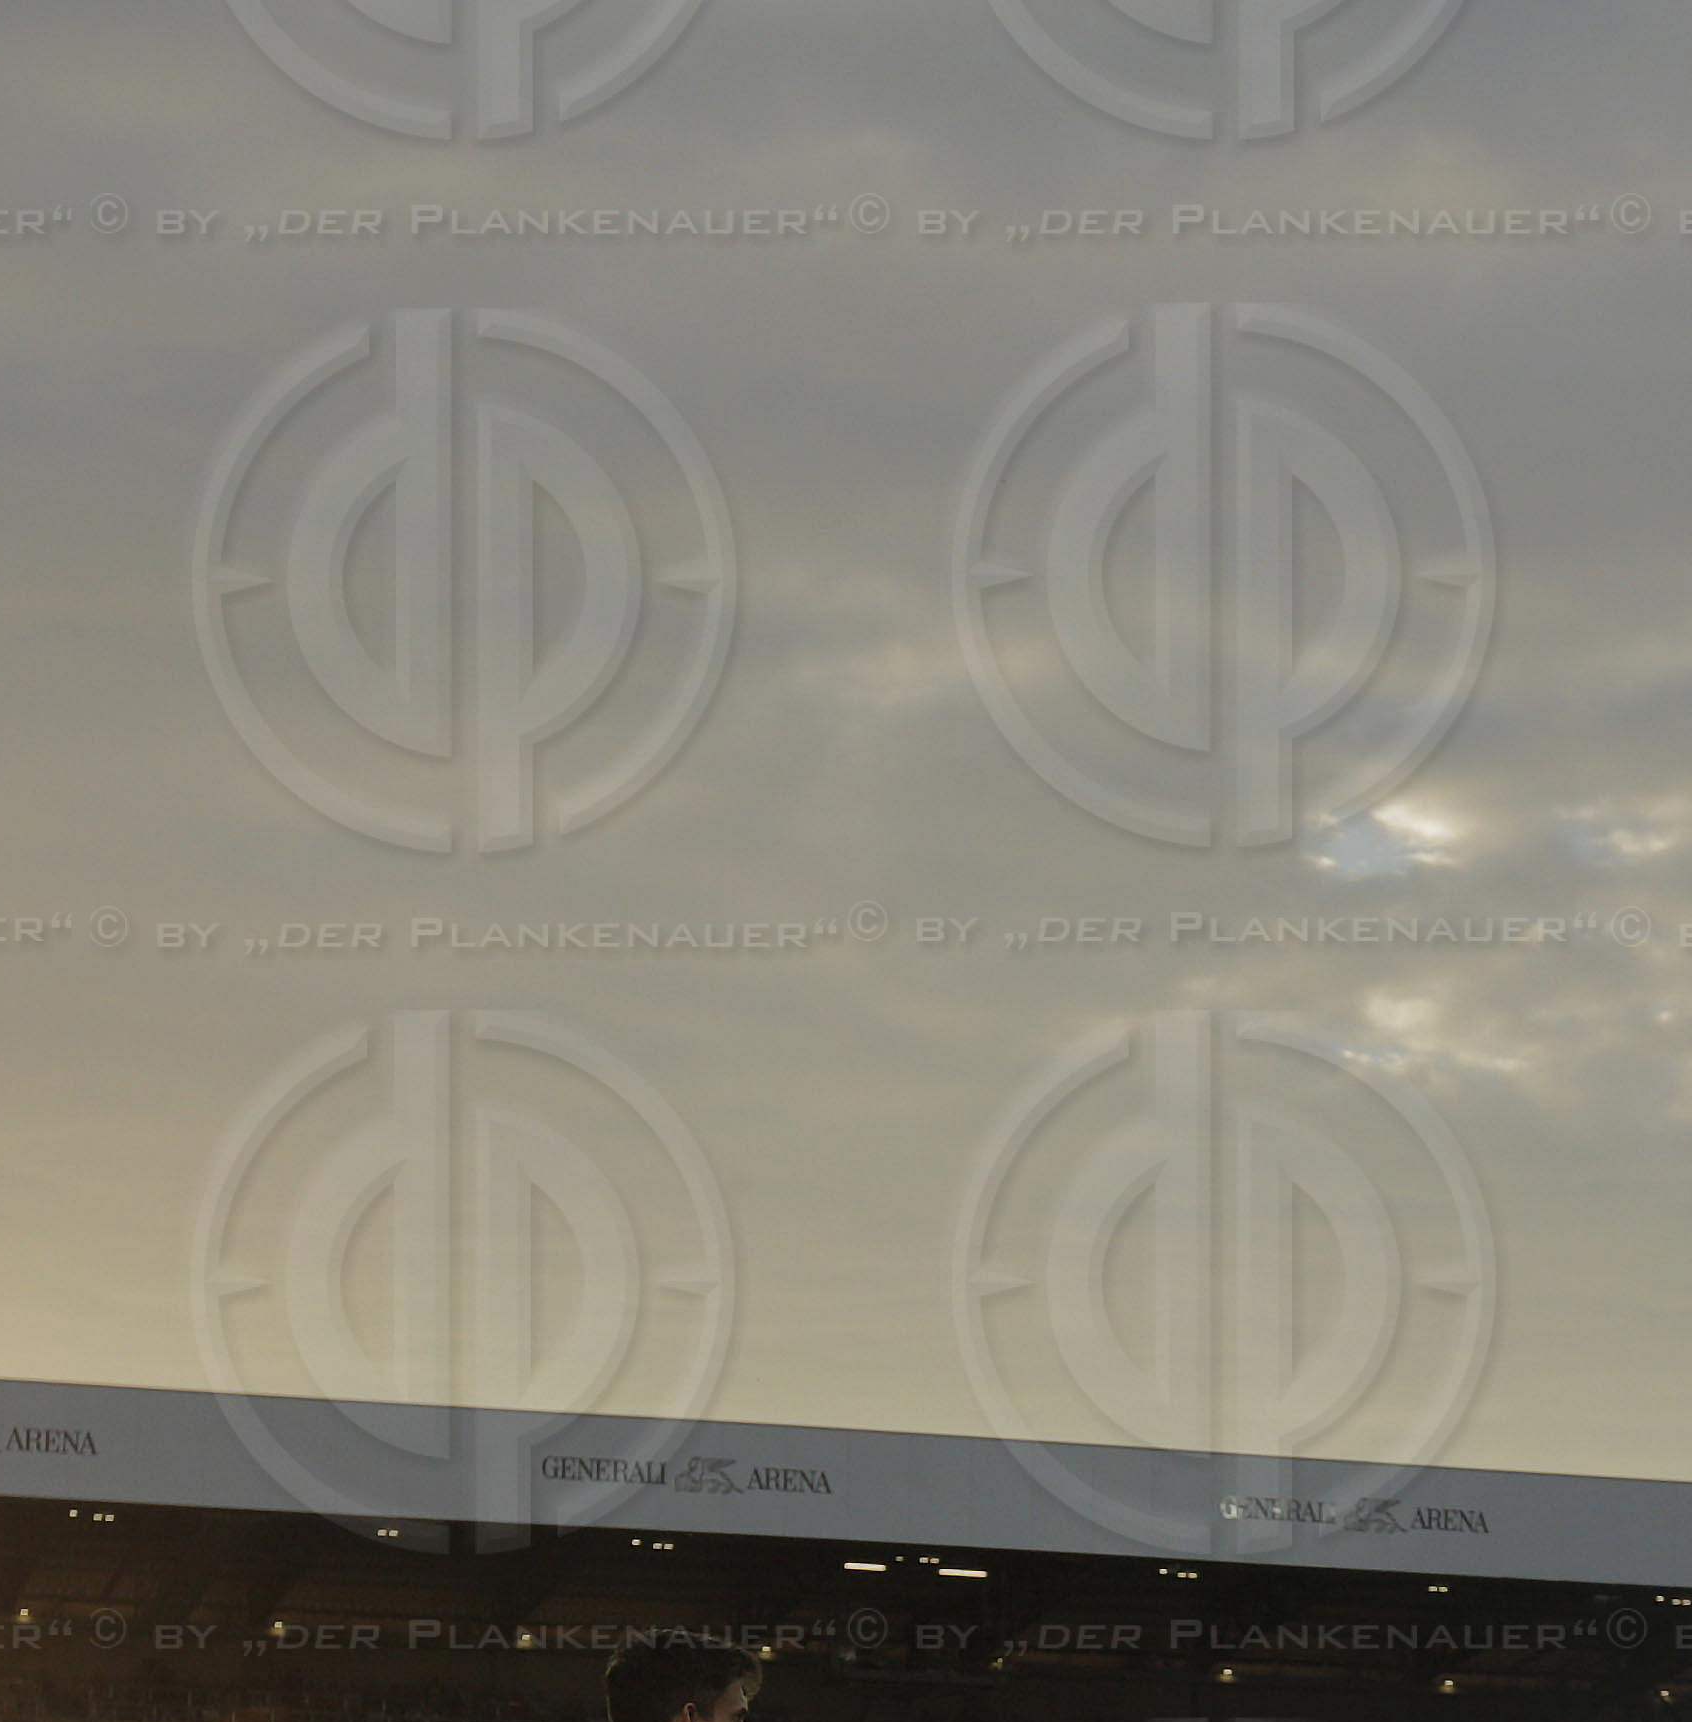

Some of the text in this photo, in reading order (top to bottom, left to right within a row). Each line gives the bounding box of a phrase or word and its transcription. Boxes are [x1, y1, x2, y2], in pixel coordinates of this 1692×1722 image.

[6, 1427, 98, 1456] ARENA
[541, 1455, 832, 1495] GENERALI ARENA
[1410, 1508, 1490, 1535] ARENA
